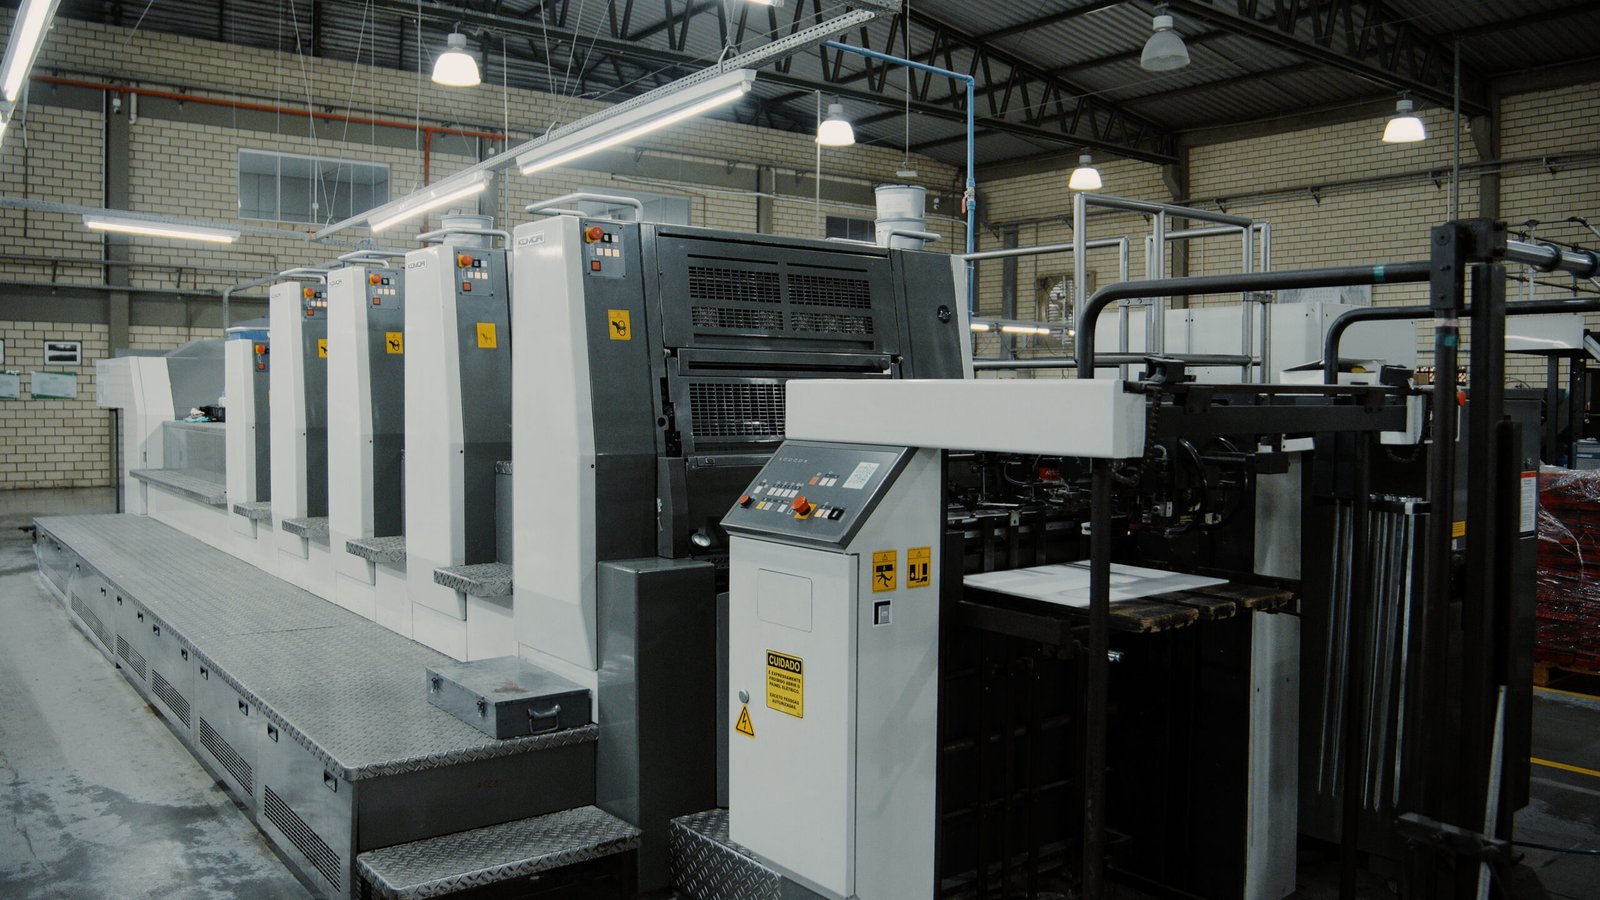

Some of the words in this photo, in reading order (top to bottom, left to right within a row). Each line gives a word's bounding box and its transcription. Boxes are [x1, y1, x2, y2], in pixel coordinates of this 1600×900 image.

[769, 655, 800, 672] CUIDADO
[772, 671, 800, 683] EXPRESSAMENTE
[784, 697, 800, 705] PESSOAS
